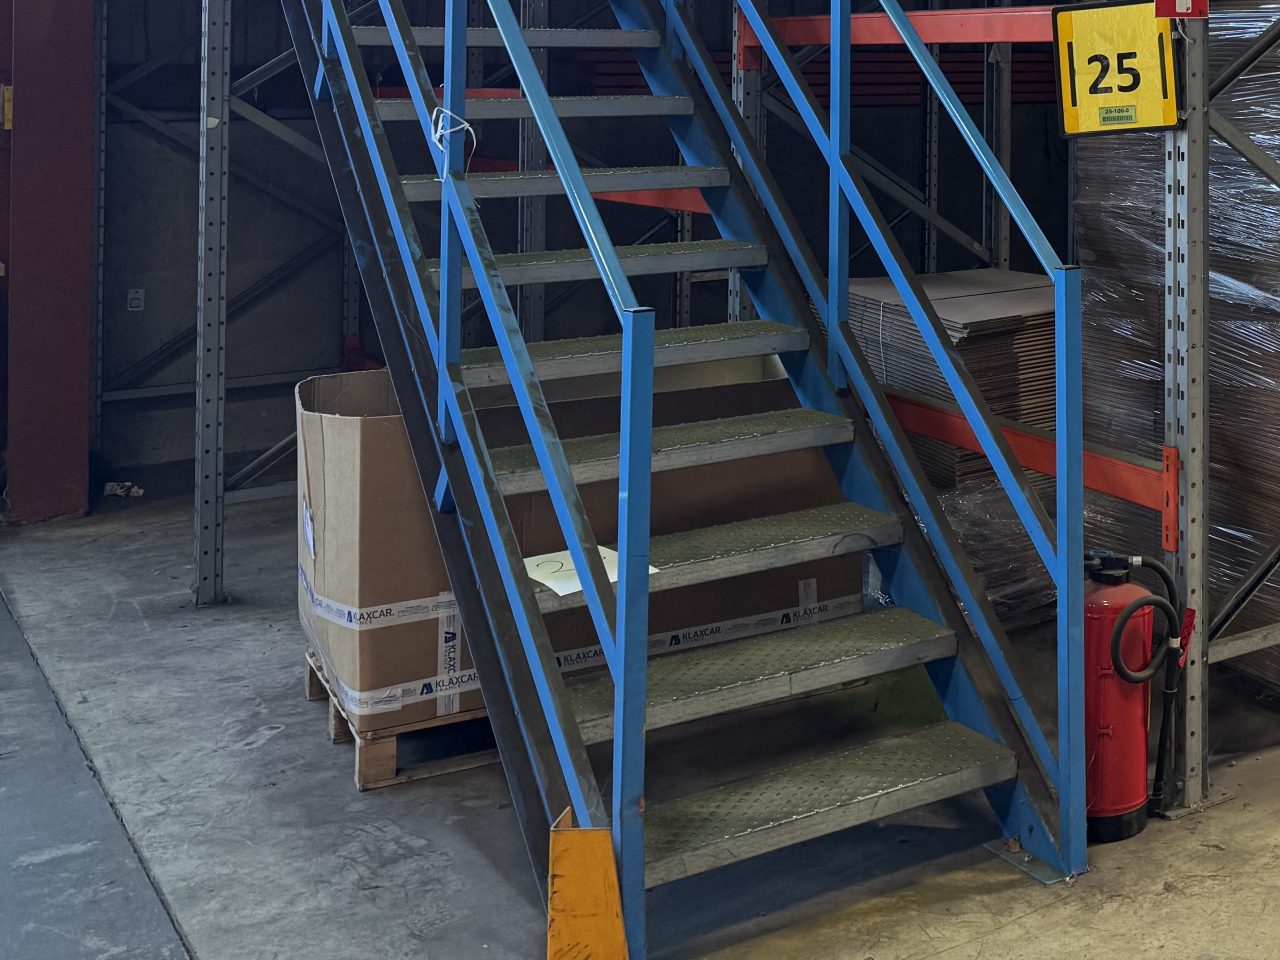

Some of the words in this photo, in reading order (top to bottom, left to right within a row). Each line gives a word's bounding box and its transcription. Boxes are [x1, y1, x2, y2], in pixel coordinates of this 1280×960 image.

[1087, 52, 1141, 95] 25
[792, 604, 828, 619] KLAXCAR
[682, 626, 722, 640] KLAXCAR
